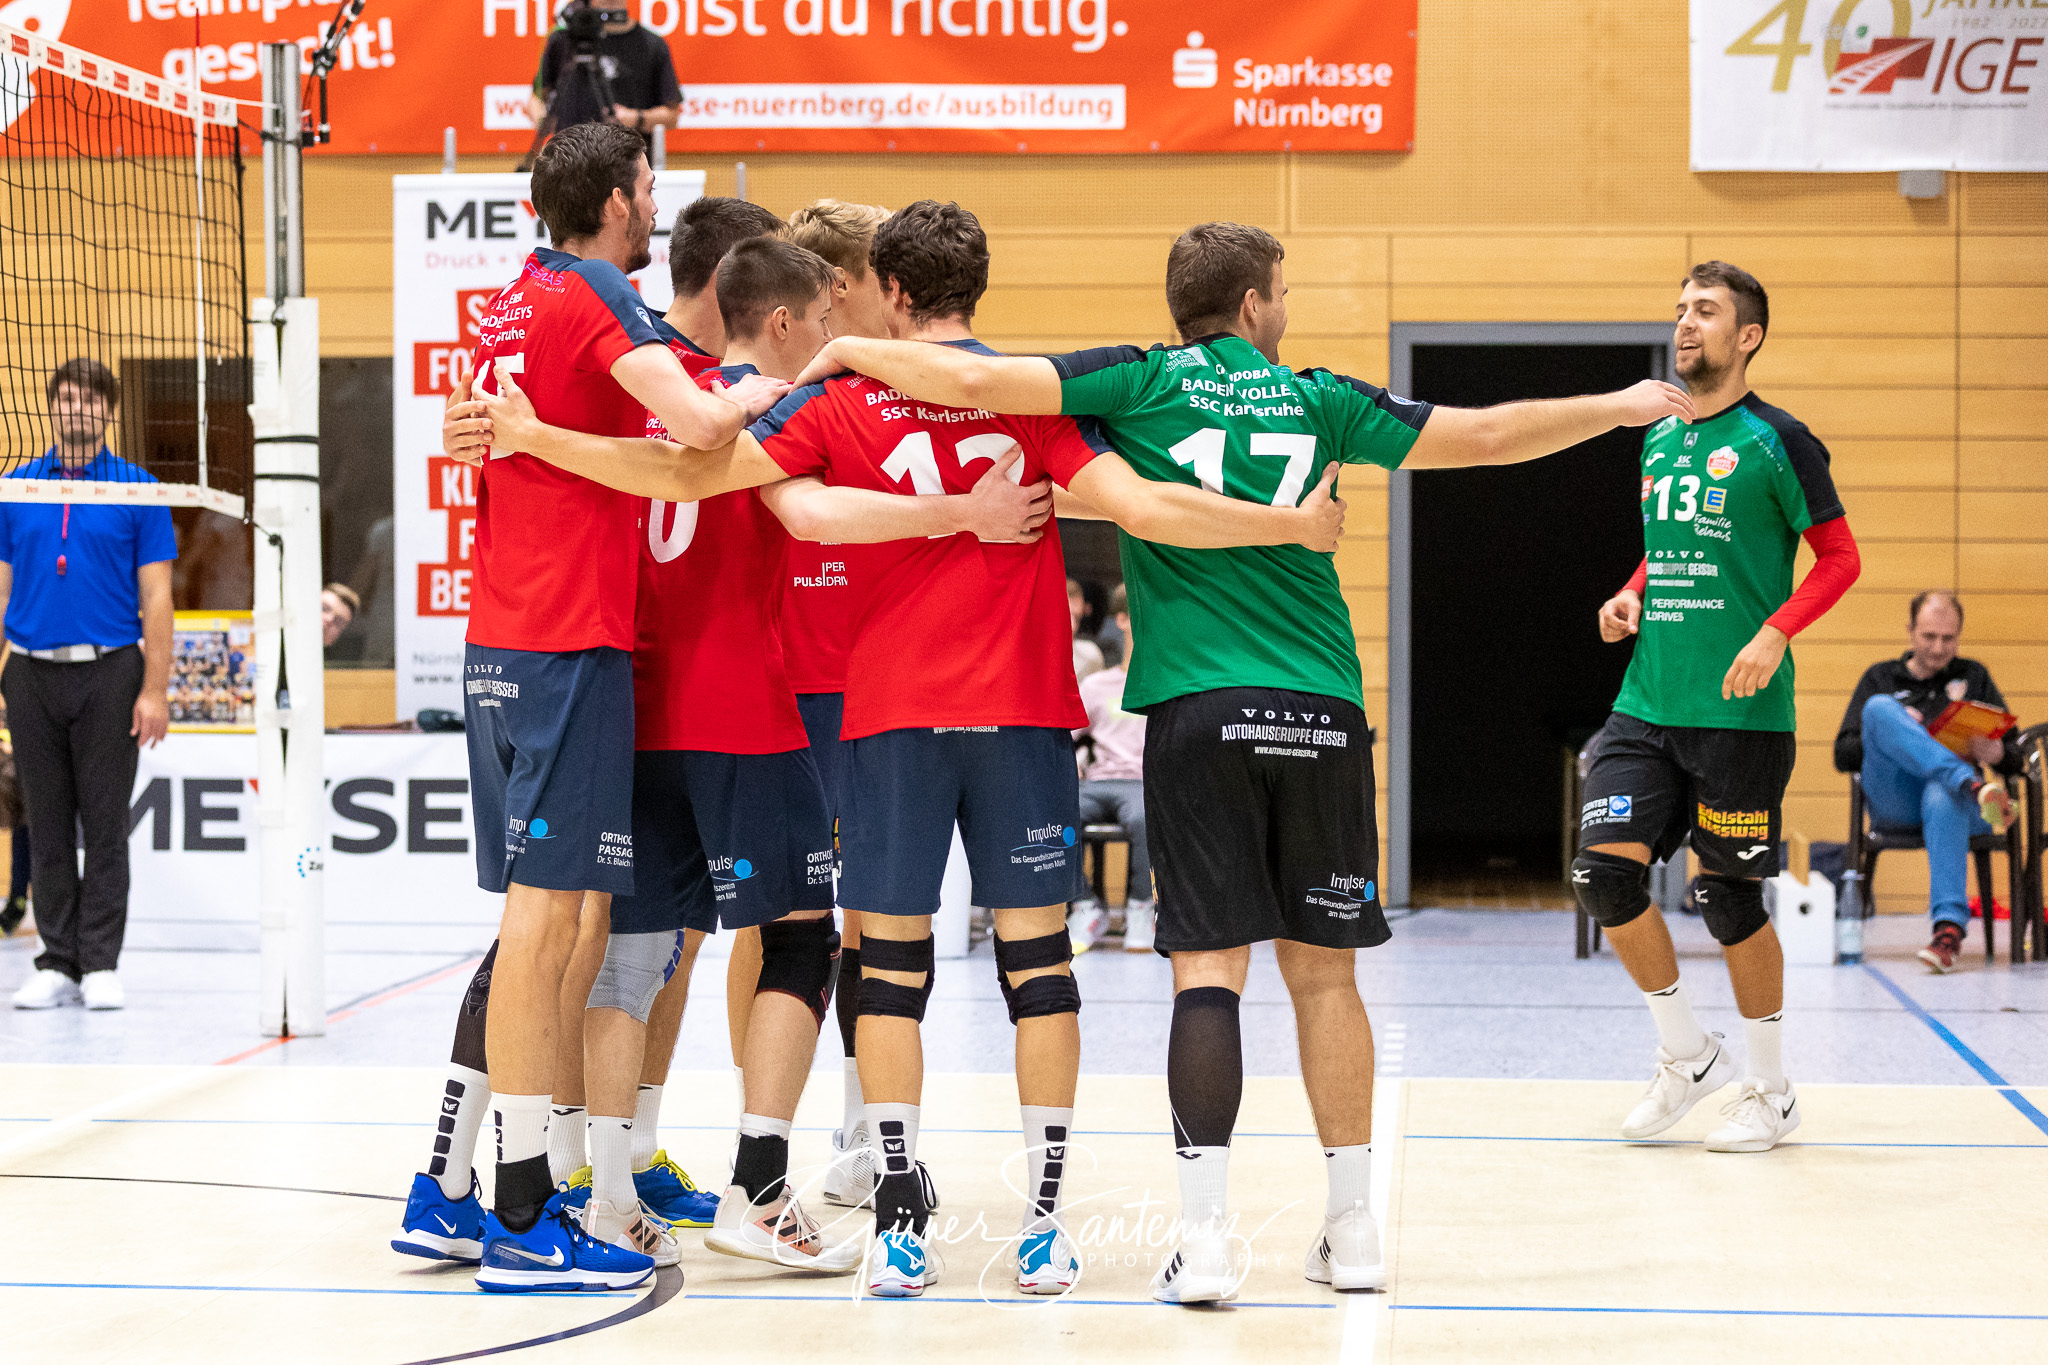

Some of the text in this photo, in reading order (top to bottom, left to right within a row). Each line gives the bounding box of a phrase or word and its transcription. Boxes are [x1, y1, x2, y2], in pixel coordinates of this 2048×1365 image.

[783, 0, 868, 36] du
[891, 0, 1129, 53] richtig.
[162, 17, 396, 92] gescht!
[1233, 56, 1394, 94] Sparkasse
[1932, 37, 2045, 95] IGE
[1233, 96, 1383, 134] Nürnberg
[1181, 378, 1234, 397] BADEN
[1189, 395, 1220, 413] SSC
[1168, 427, 1317, 508] 17
[1653, 475, 1701, 521] 13
[793, 576, 823, 587] PULS
[1652, 598, 1725, 610] PERFORMANCE
[467, 664, 502, 675] VOLVO
[1241, 708, 1331, 724] VOLVO
[1221, 723, 1347, 748] AUTOHAUSGRUPPE GEISSER
[1026, 823, 1063, 843] Impulse
[597, 855, 606, 864] Dr.
[598, 844, 633, 858] PASSAG
[1010, 855, 1022, 864] Das
[1330, 872, 1365, 893] Implse
[1305, 895, 1317, 904] Das
[1328, 910, 1338, 918] am
